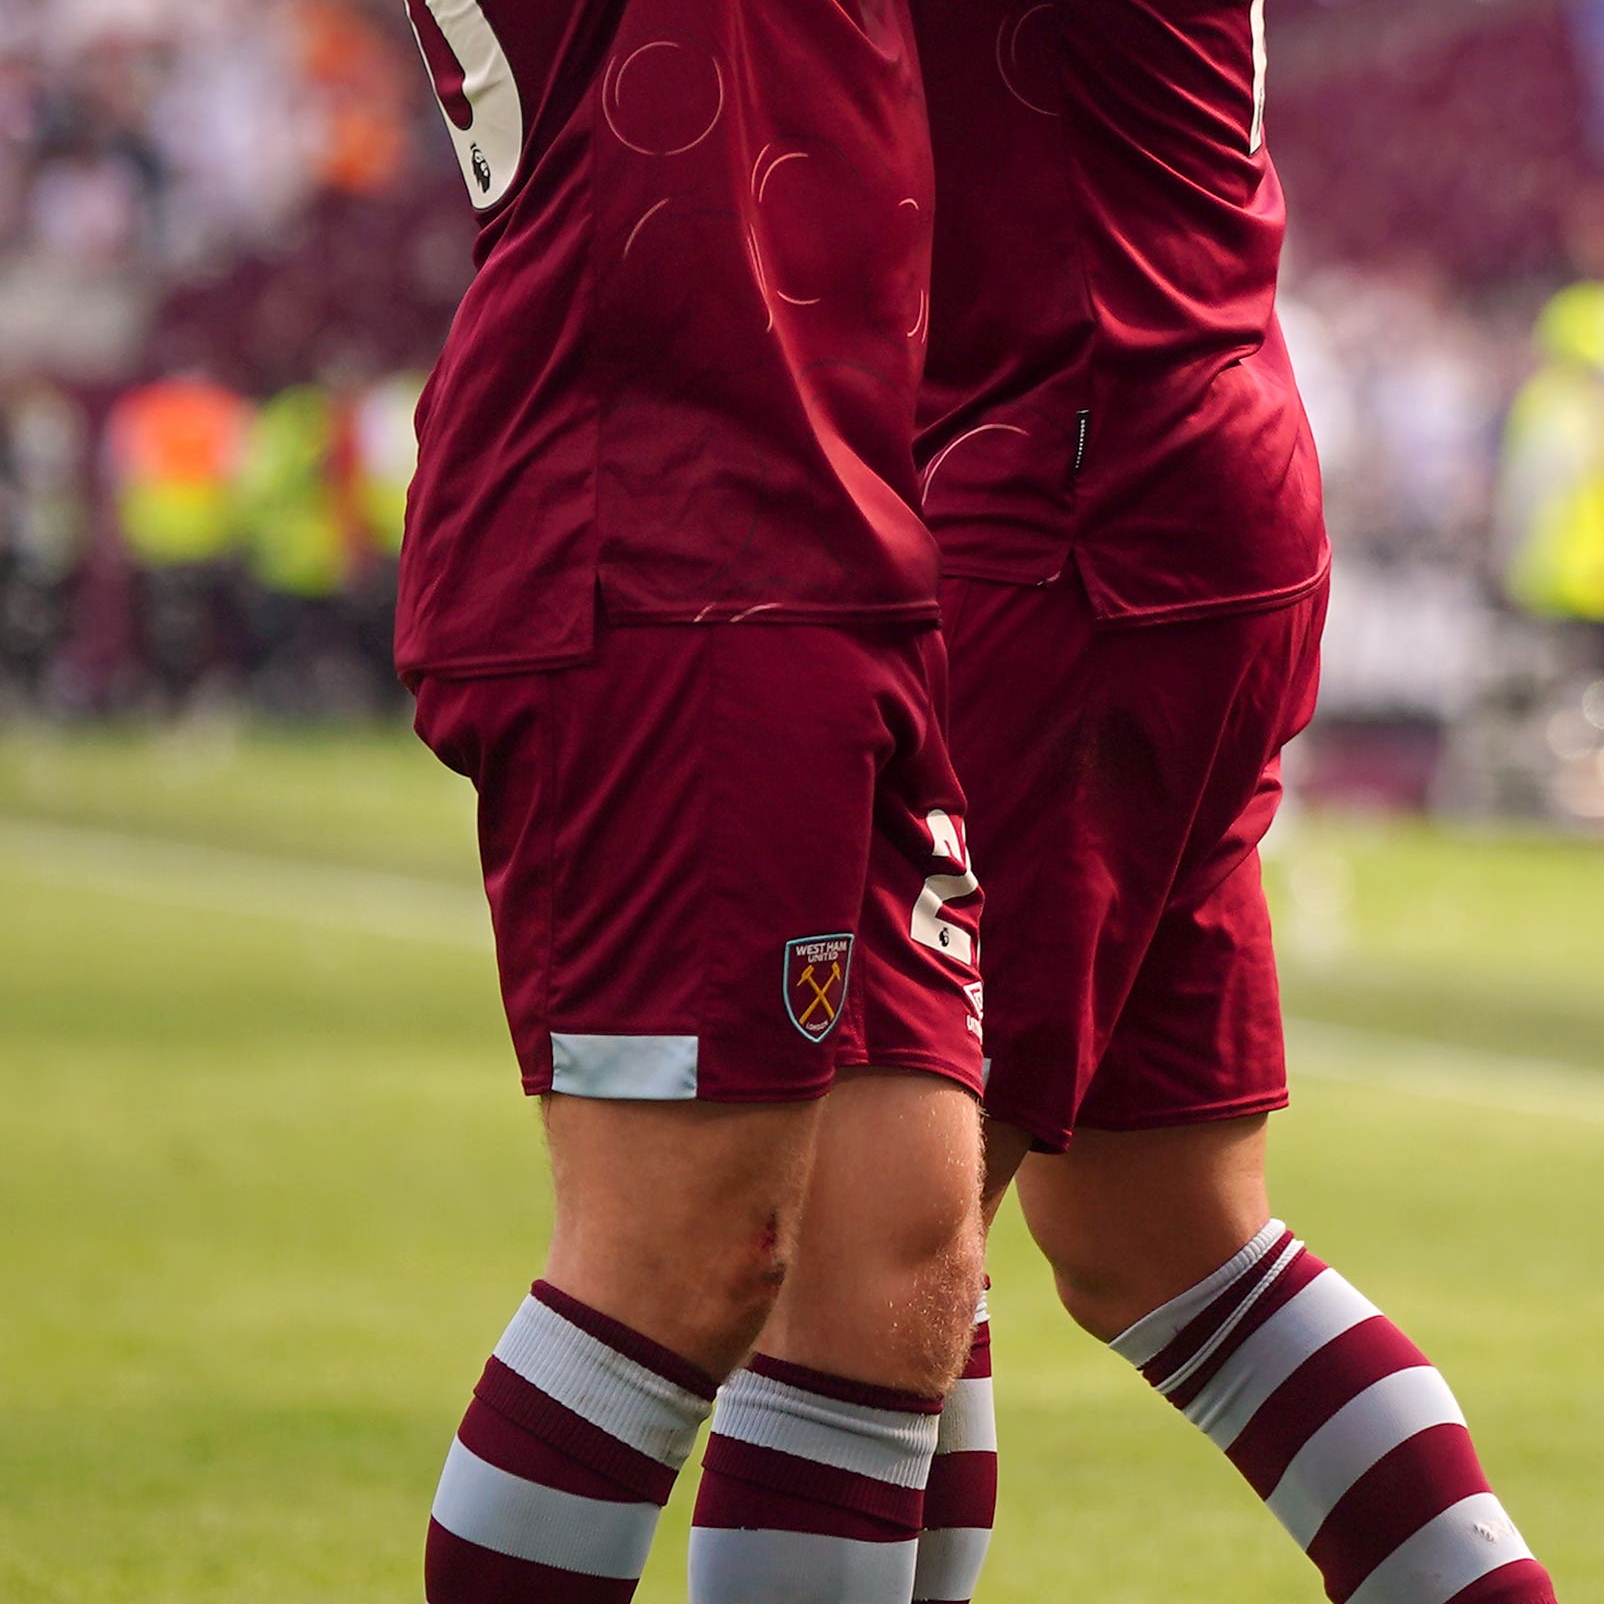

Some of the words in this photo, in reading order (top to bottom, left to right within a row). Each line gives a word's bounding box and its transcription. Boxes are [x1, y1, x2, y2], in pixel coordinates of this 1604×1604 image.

[795, 942, 825, 956] WEST
[827, 940, 848, 952] HAM
[807, 952, 839, 964] UNITED
